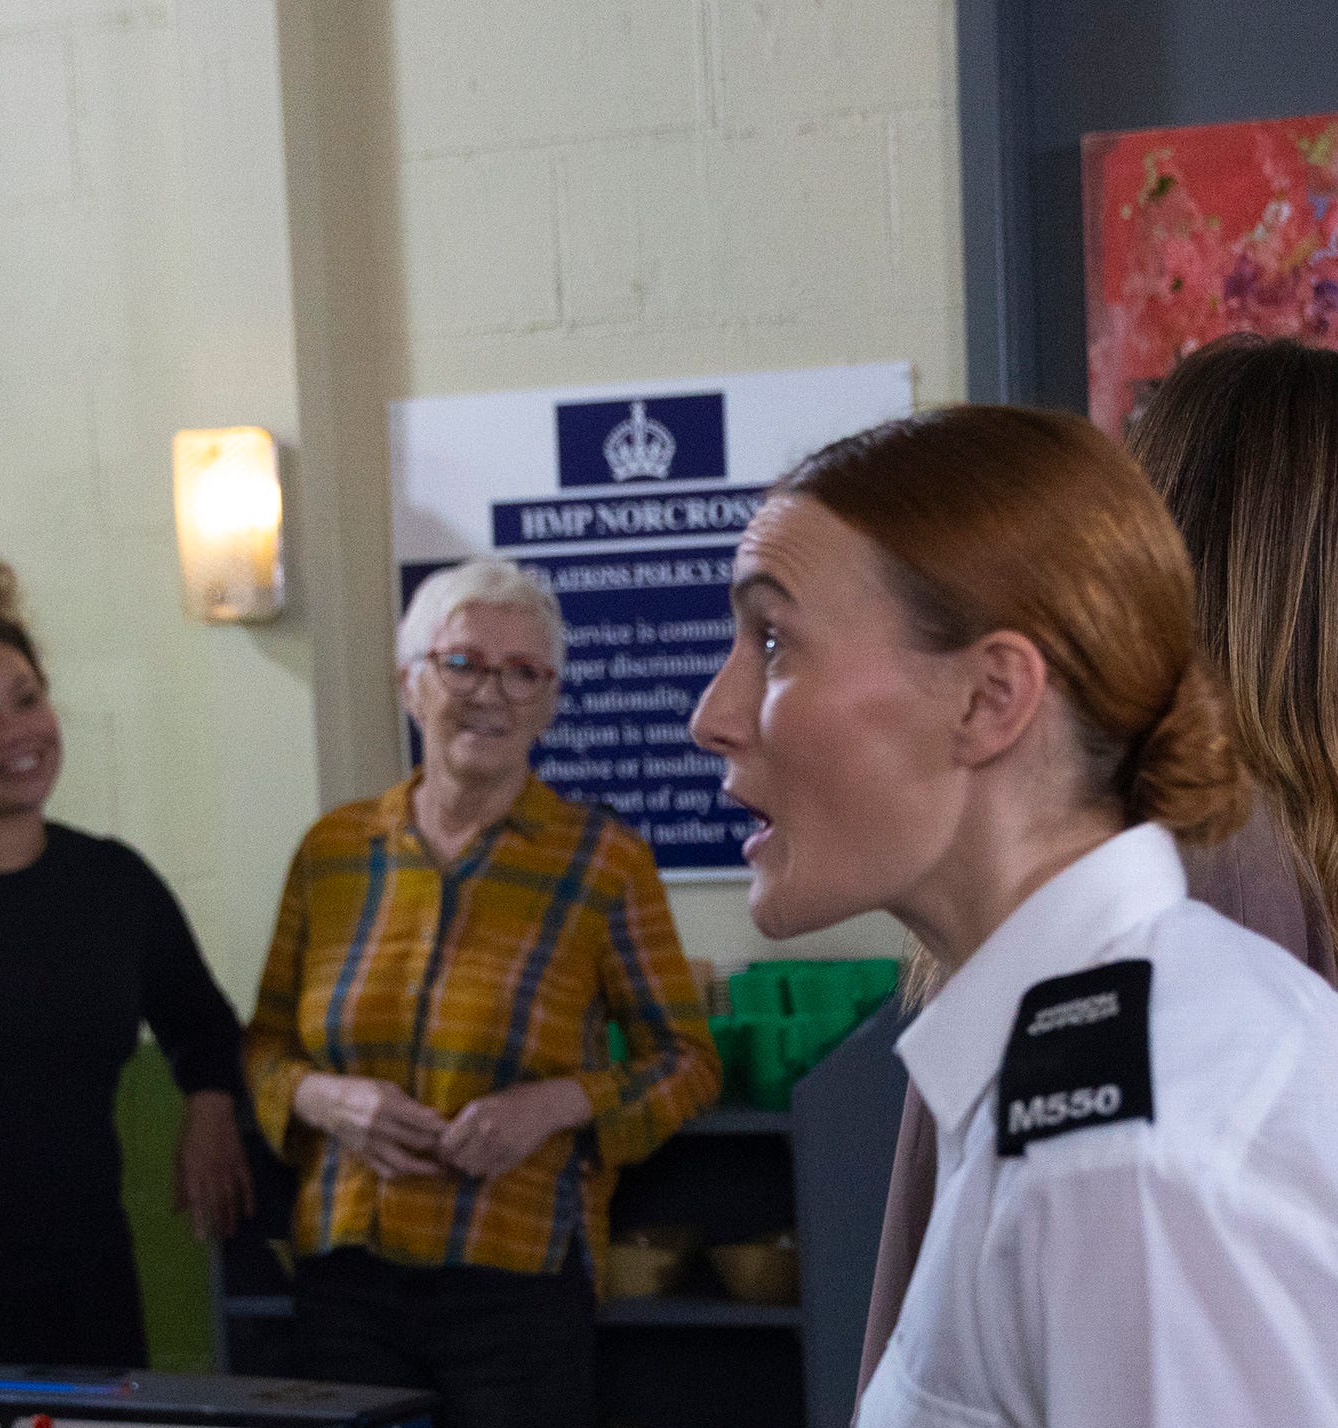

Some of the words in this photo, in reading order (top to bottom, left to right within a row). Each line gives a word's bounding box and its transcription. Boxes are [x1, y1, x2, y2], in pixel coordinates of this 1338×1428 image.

[521, 503, 593, 540] HMP
[632, 558, 713, 589] POLICY
[636, 617, 656, 644] is
[1008, 1084, 1121, 1134] M550
